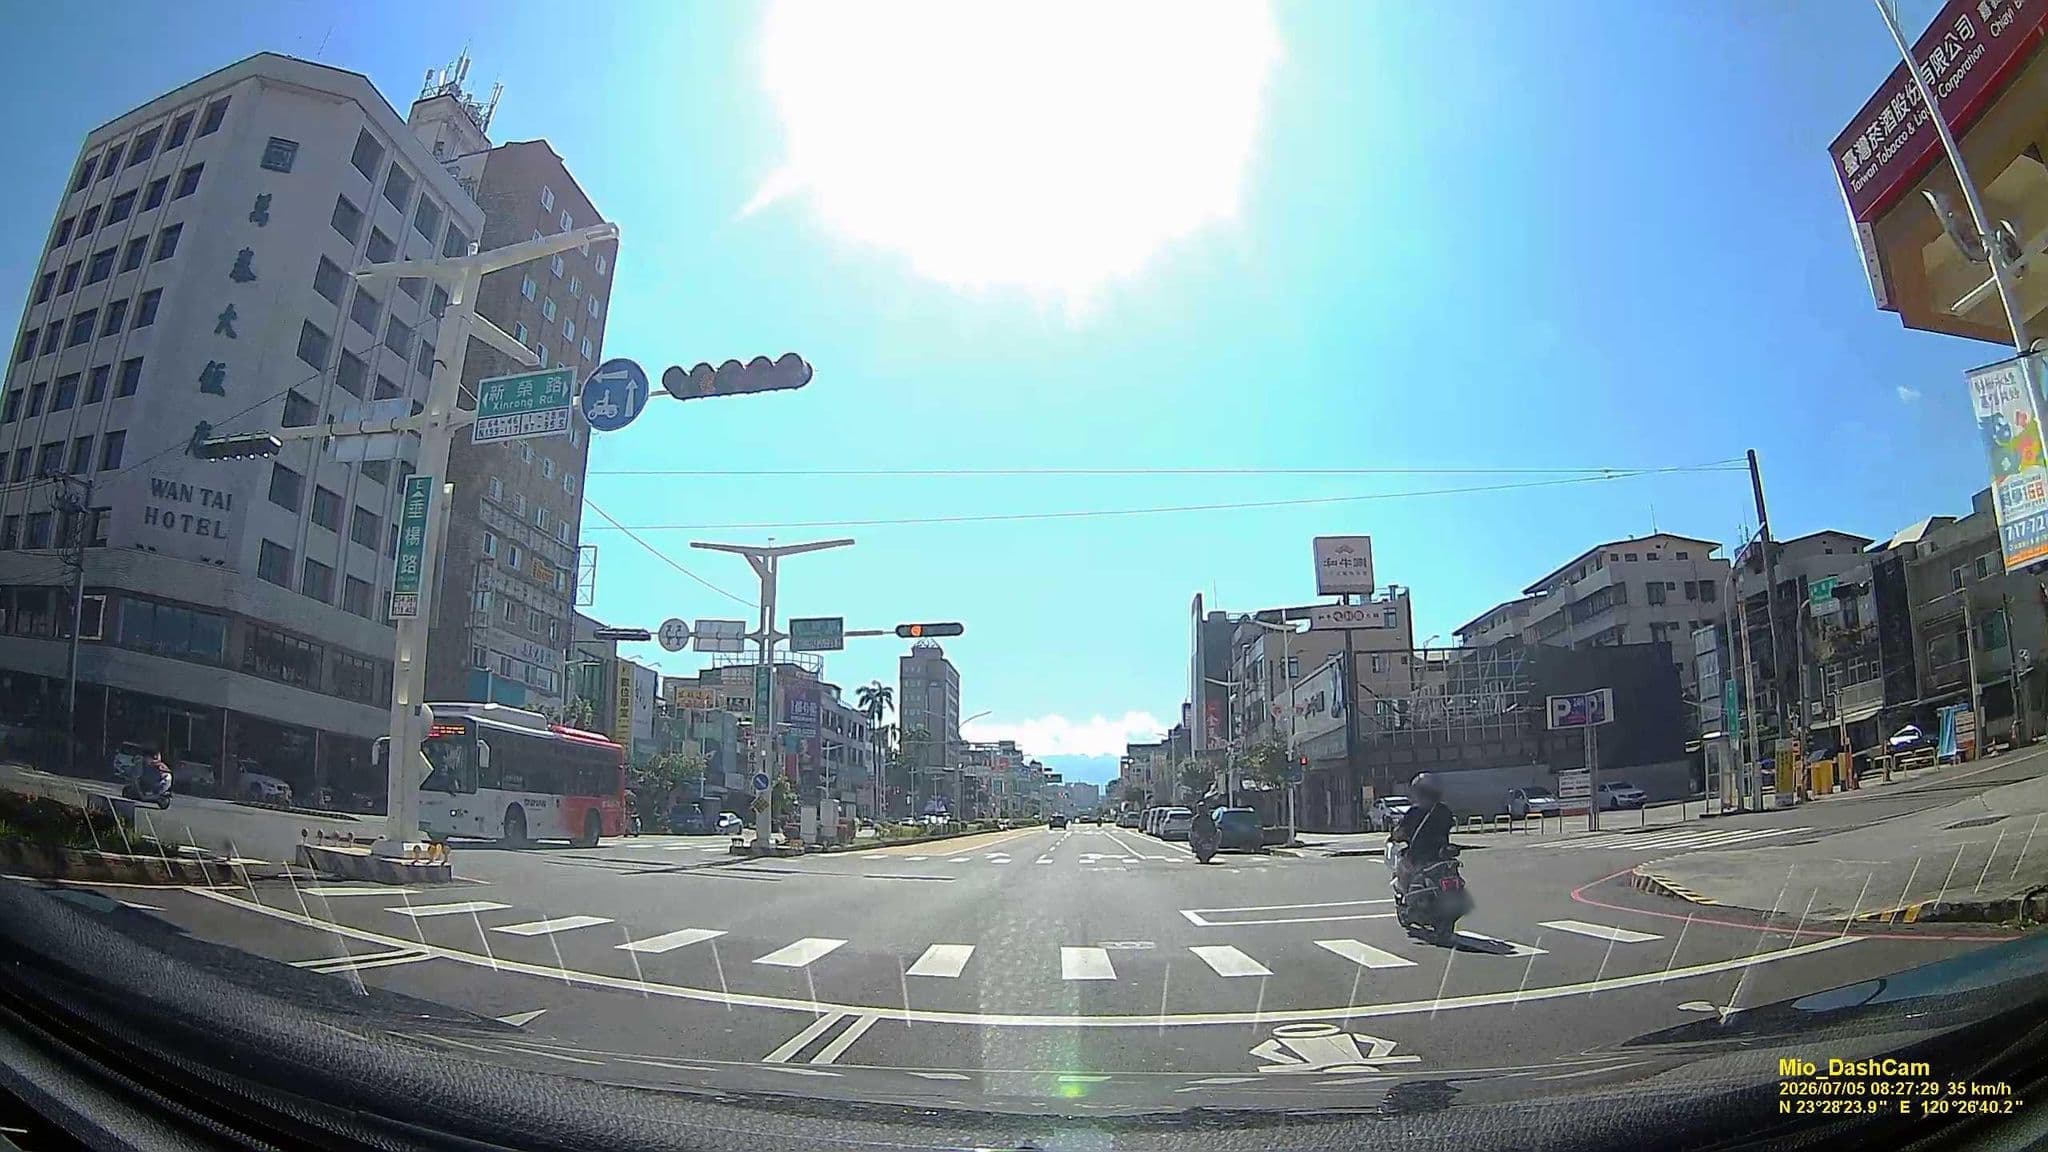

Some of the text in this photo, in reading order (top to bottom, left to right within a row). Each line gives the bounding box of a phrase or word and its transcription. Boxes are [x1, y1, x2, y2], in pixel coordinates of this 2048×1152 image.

[1850, 163, 1879, 193] Taiwan
[1876, 130, 1908, 166] Tobacco
[1906, 122, 1916, 135] &
[1938, 43, 1986, 98] Corporation
[1990, 4, 2015, 37] Chiayi
[489, 376, 562, 402] 新榮路
[493, 399, 533, 411] Xinrong
[151, 477, 233, 511] WAN TAI
[144, 505, 227, 539] HOTEL
